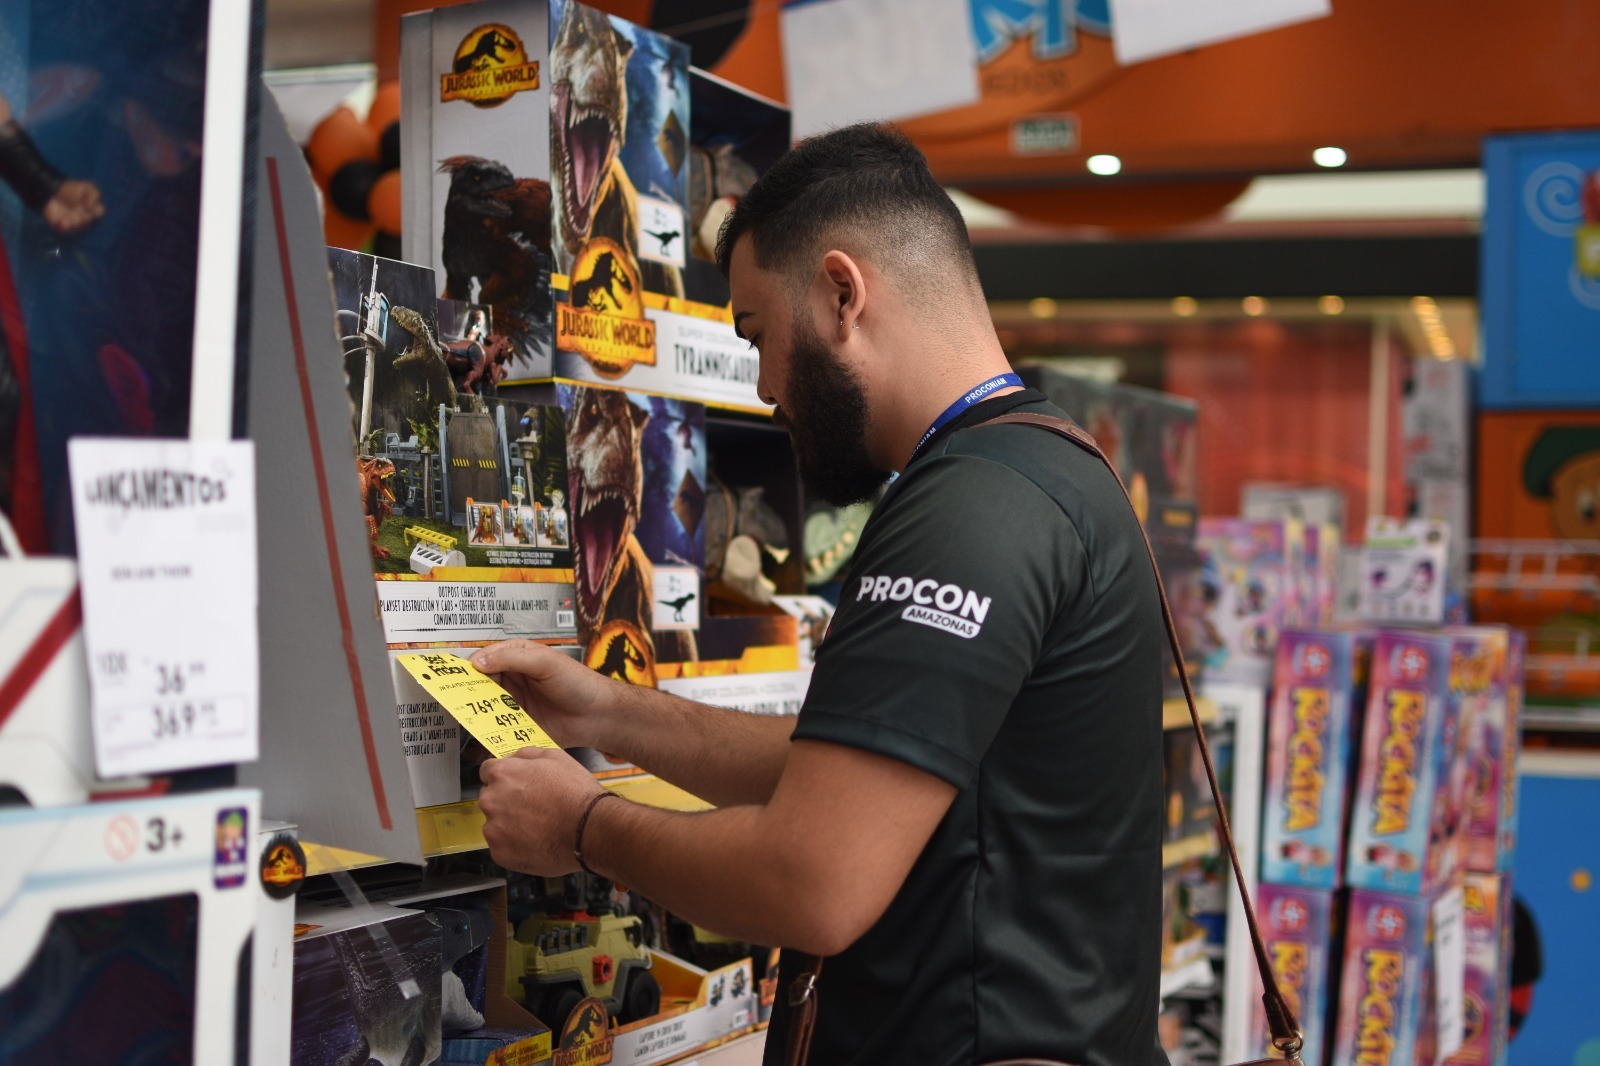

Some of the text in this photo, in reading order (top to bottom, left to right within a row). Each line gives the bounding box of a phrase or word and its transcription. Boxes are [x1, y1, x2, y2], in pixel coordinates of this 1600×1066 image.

[445, 72, 490, 94] JURASSIC
[493, 65, 536, 87] WORLD
[561, 308, 654, 350] JURASSIC WORLD
[438, 586, 496, 598] OUTPOST CHAOS PLAYSET
[402, 597, 434, 612] DESTRUCCIÓN
[435, 600, 439, 611] Y
[441, 600, 454, 611] CAOS
[459, 600, 478, 612] COFFRET
[480, 600, 486, 611] DE
[496, 600, 510, 612] CHAOS
[856, 575, 992, 625] PROCON
[434, 613, 458, 625] CONJUNTO
[488, 614, 492, 624] E
[493, 613, 505, 625] CAOS
[907, 608, 974, 636] AMAZONAS
[406, 703, 420, 714] CHAOS
[428, 716, 432, 726] Y
[433, 716, 444, 726] CAOS
[403, 731, 418, 742] CHAOS
[486, 735, 505, 745] 10X
[435, 743, 446, 754] CAOS
[147, 816, 185, 853] 3+
[585, 1040, 611, 1062] WORLD
